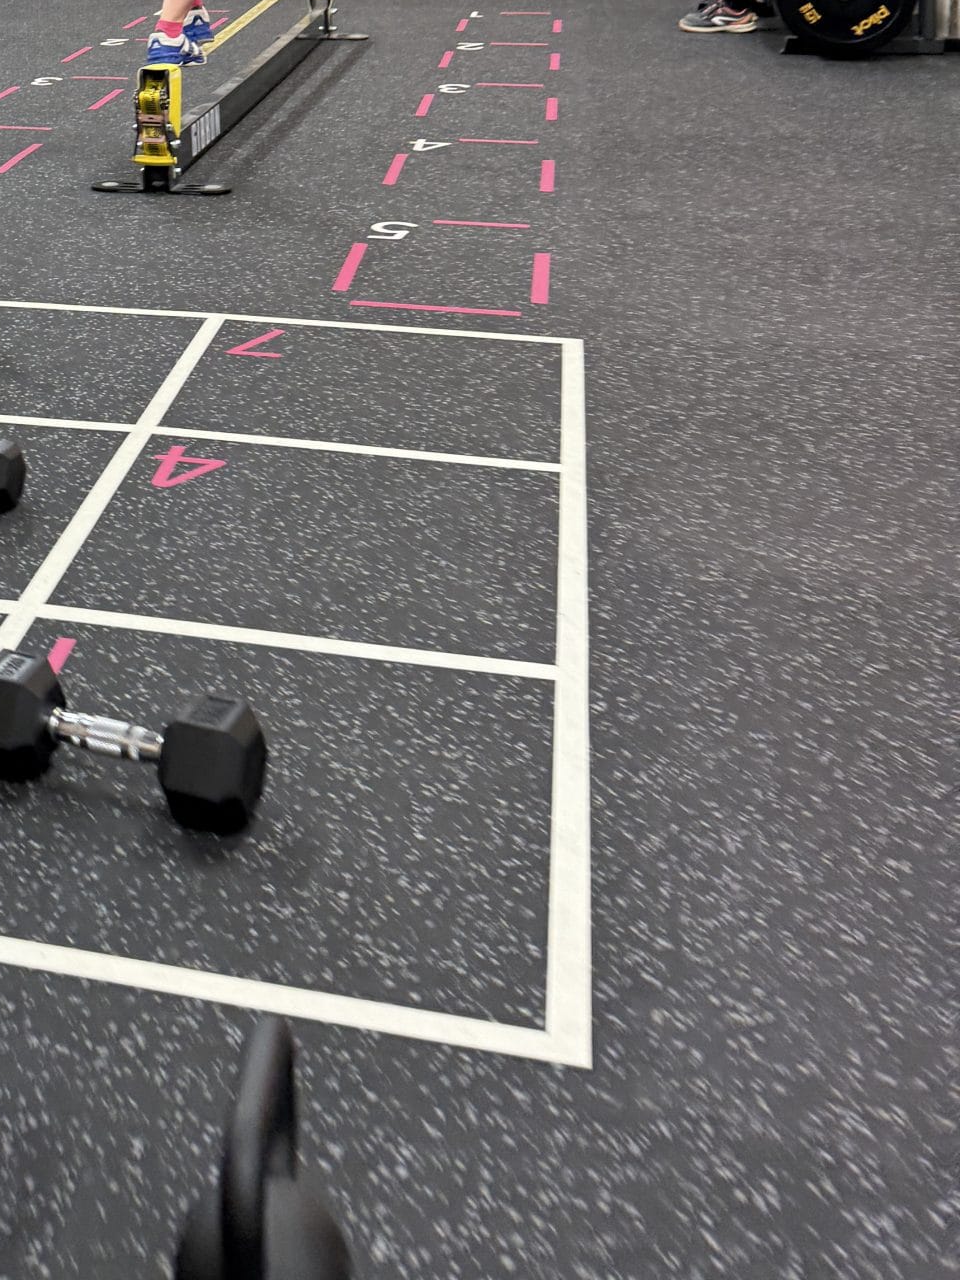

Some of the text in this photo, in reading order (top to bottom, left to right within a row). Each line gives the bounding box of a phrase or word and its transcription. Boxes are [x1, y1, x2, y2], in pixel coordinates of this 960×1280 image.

[100, 38, 129, 46] 2
[456, 42, 485, 51] 2
[31, 76, 63, 86] 3
[438, 83, 471, 94] 3
[409, 138, 453, 152] 4
[367, 221, 419, 240] 5
[224, 329, 286, 357] 7
[151, 446, 227, 487] 4
